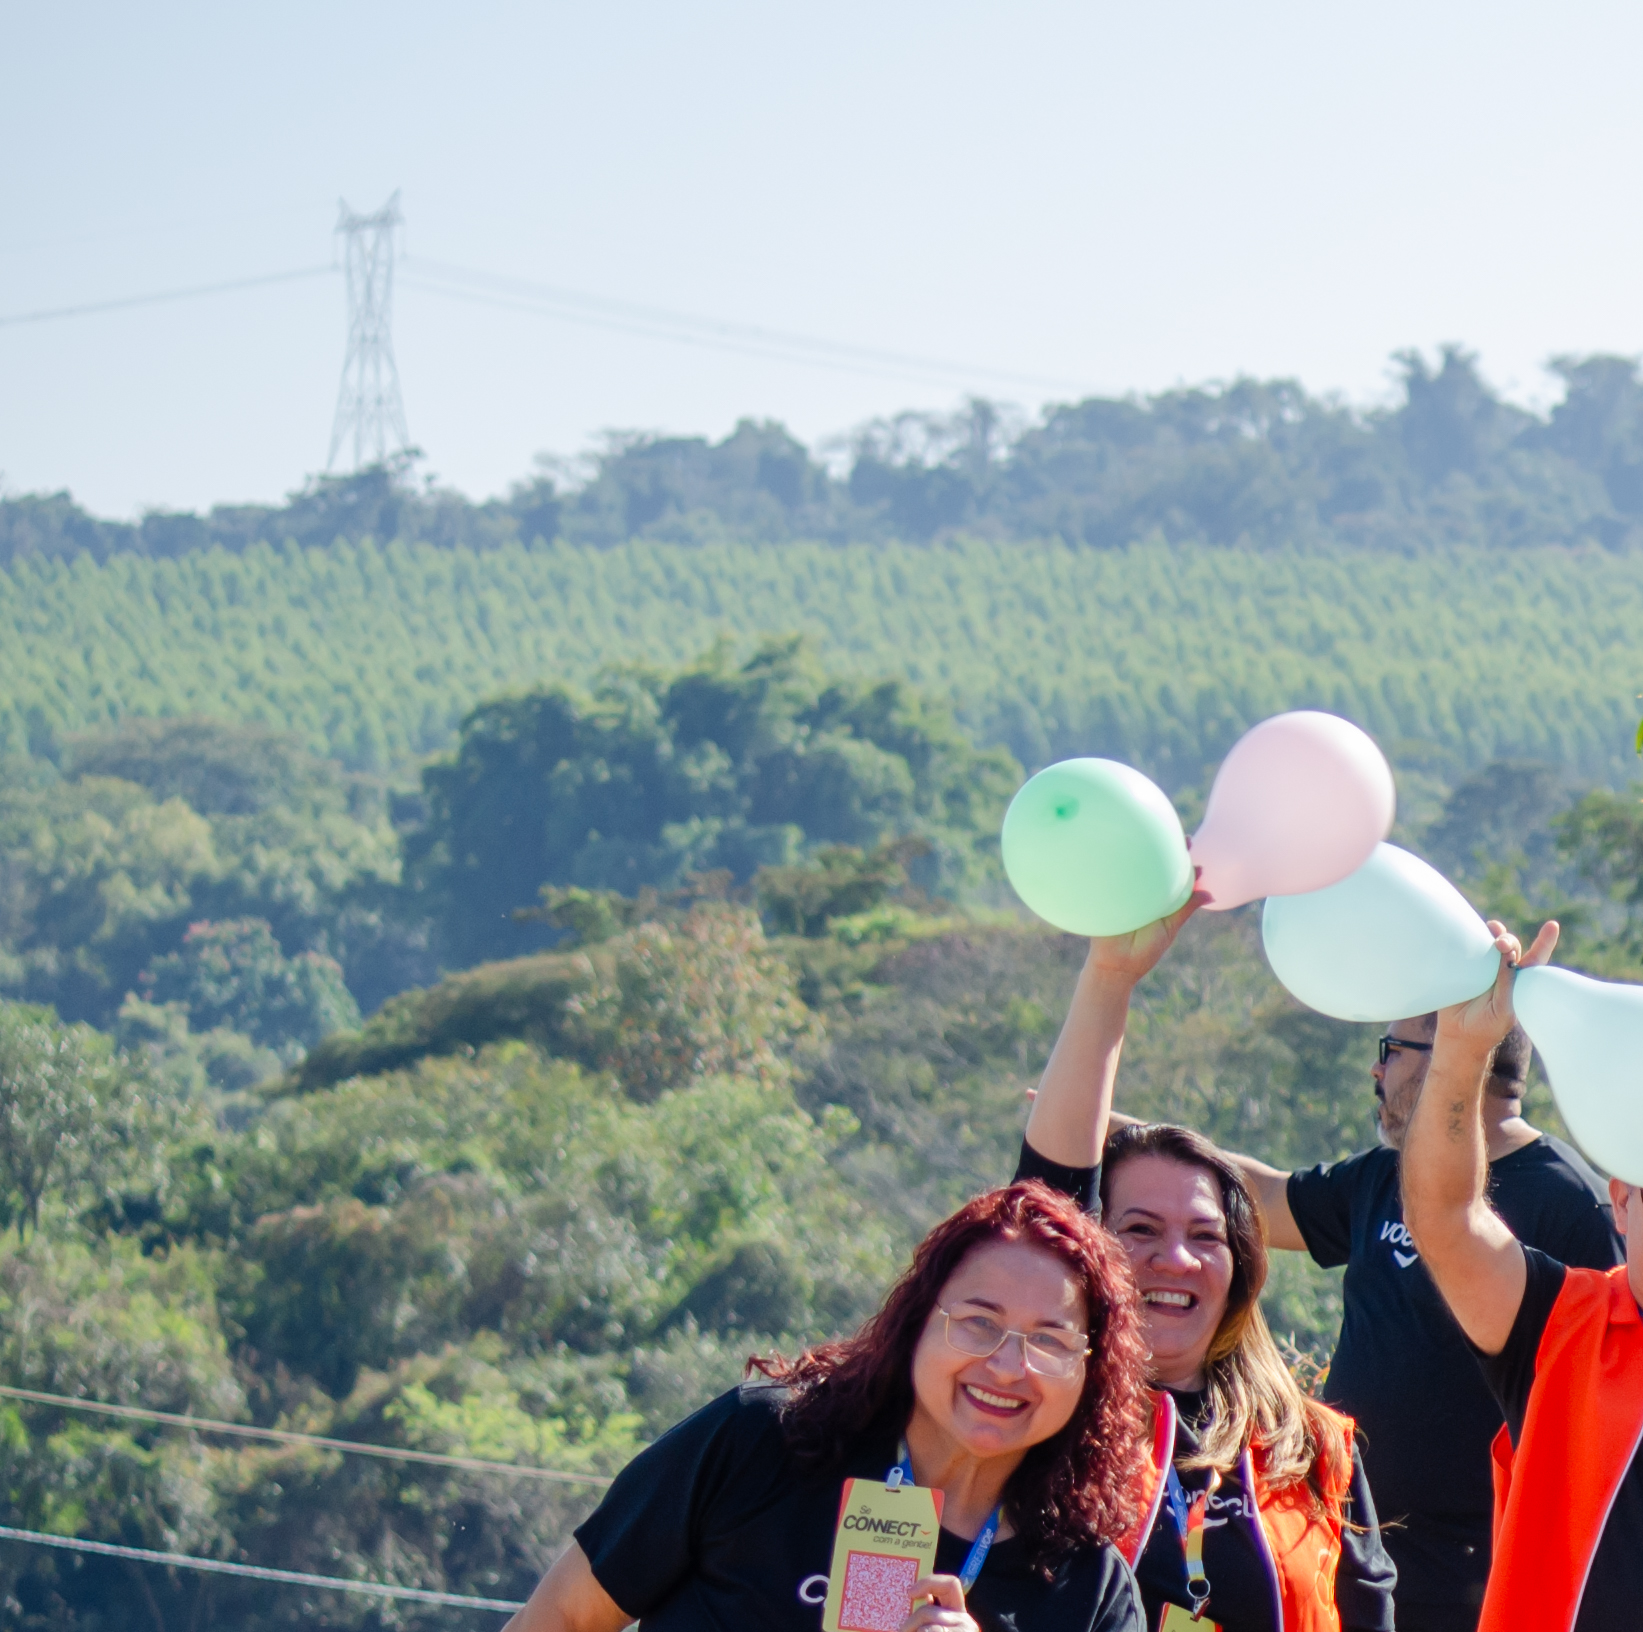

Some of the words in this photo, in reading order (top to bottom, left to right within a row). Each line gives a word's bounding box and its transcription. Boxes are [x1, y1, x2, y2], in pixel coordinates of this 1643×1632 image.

[860, 1505, 872, 1515] Se
[843, 1514, 921, 1537] CONNECT
[873, 1536, 893, 1544] com
[902, 1539, 933, 1549] gente!
